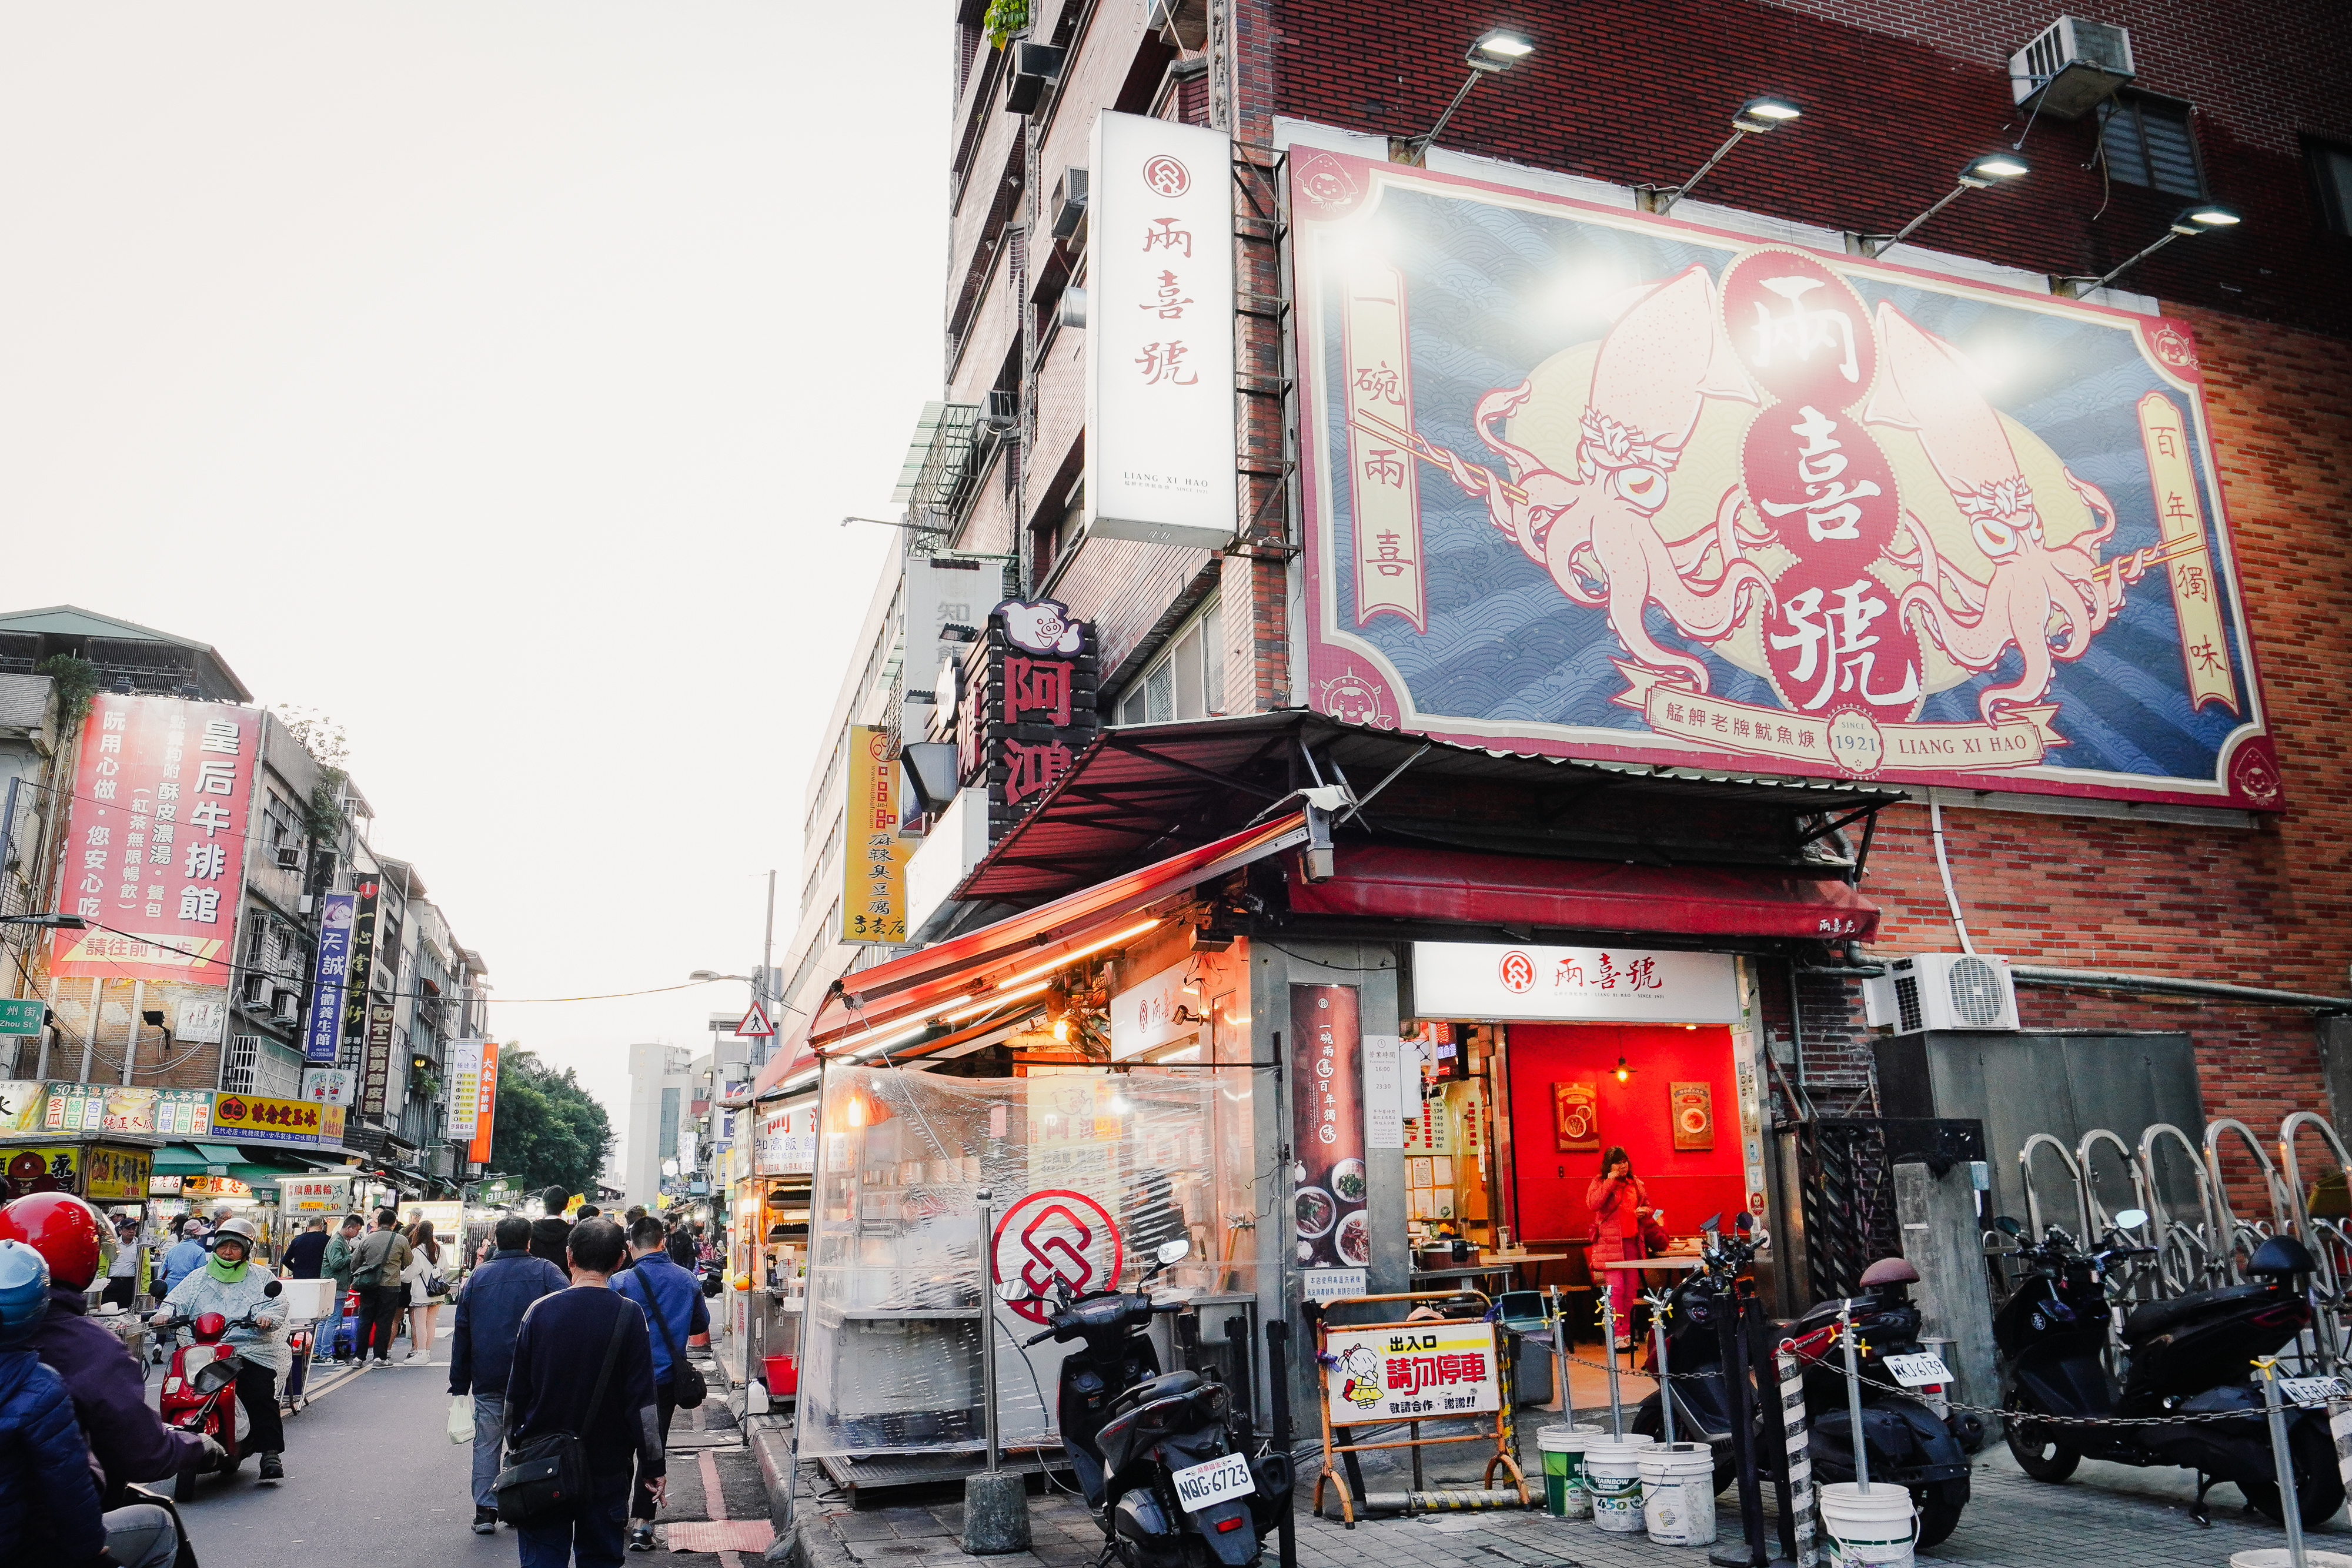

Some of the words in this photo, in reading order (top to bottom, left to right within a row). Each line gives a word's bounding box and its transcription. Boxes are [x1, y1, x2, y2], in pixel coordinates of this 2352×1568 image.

[1134, 217, 1199, 386] 兩喜號
[1352, 294, 1417, 578] 一碗兩喜
[1124, 472, 1158, 482] LIANG
[1185, 479, 1208, 487] HAO
[1750, 276, 1922, 711] 兩喜號
[2148, 424, 2227, 678] 百年獨味
[1841, 721, 1866, 730] SINCE
[1835, 734, 1876, 752] 1921
[1898, 738, 1955, 755] LIANG
[1964, 737, 1982, 754] XI
[1989, 734, 2027, 753] HAO
[178, 717, 240, 924] 皇后牛排館
[868, 831, 896, 915] 麻辣臭豆腐
[85, 937, 193, 960] 請往前十步
[1554, 952, 1663, 991] 兩喜號
[46, 1098, 64, 1126] 冬瓜
[66, 1099, 81, 1126] 綠豆
[85, 1099, 101, 1127] 杏仁
[102, 1116, 155, 1131] 純正冬瓜
[159, 1104, 172, 1131] 青草
[193, 1105, 207, 1132] 楊桃
[1389, 1335, 1437, 1352] 出入口
[1385, 1352, 1487, 1396] 請勿停車
[1595, 1477, 1629, 1485] RAINBOW
[1597, 1497, 1628, 1510] 450
